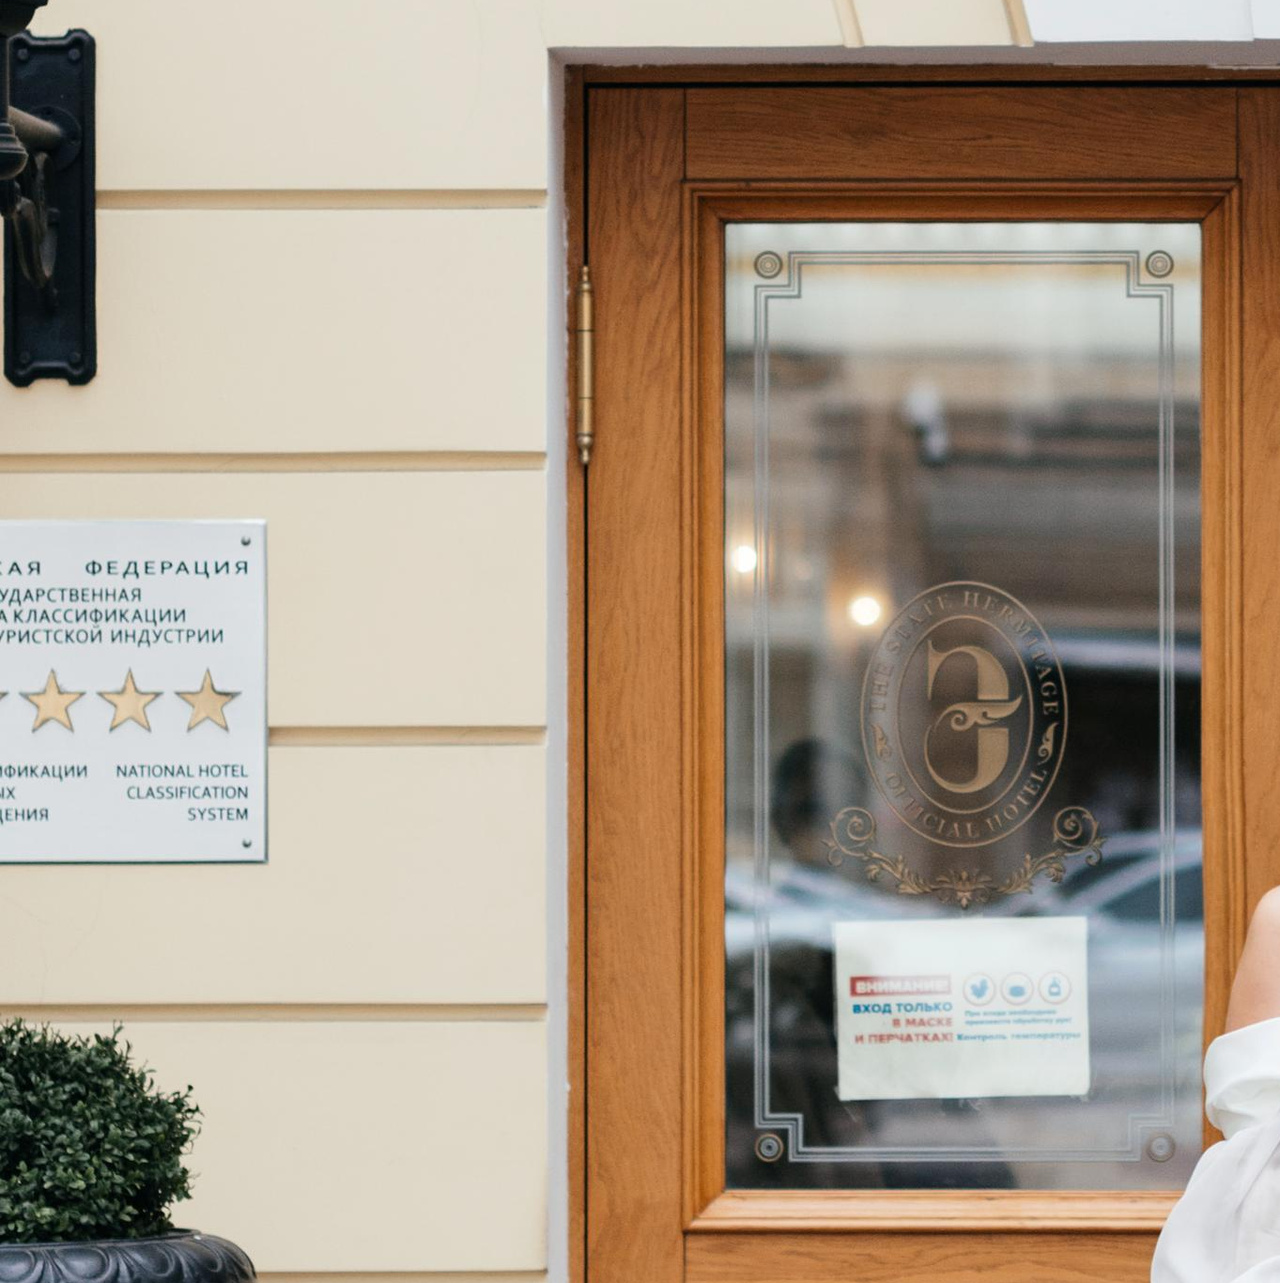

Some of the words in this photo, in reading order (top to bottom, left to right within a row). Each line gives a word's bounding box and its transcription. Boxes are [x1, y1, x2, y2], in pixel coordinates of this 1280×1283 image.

[0, 561, 41, 575] АЯ
[85, 560, 249, 579] ФЕДЕРАЦИЯ
[13, 608, 186, 626] КЛАССИФИКАЦИИ
[110, 629, 224, 648] ИНДУСТРИИ
[870, 662, 895, 713] THE
[887, 595, 953, 655] STATE
[963, 590, 1059, 716] HERMITAGE
[0, 765, 88, 781] ФИКАЦИИ
[116, 764, 194, 778] NATIONAL
[198, 764, 249, 778] HOTEL
[127, 786, 249, 800] CLASSIFICATION
[986, 768, 1050, 833] HOTEL
[0, 808, 49, 823] ЕНИЯ
[187, 807, 249, 821] SYSTEM
[853, 1003, 892, 1015] ВХОД
[896, 1002, 953, 1013] ТОЛЬКО
[892, 1018, 901, 1028] В
[905, 1017, 953, 1027] МАСКЕ
[855, 1034, 864, 1044] И
[868, 1033, 953, 1044] ПЕРЧАТКАХ!
